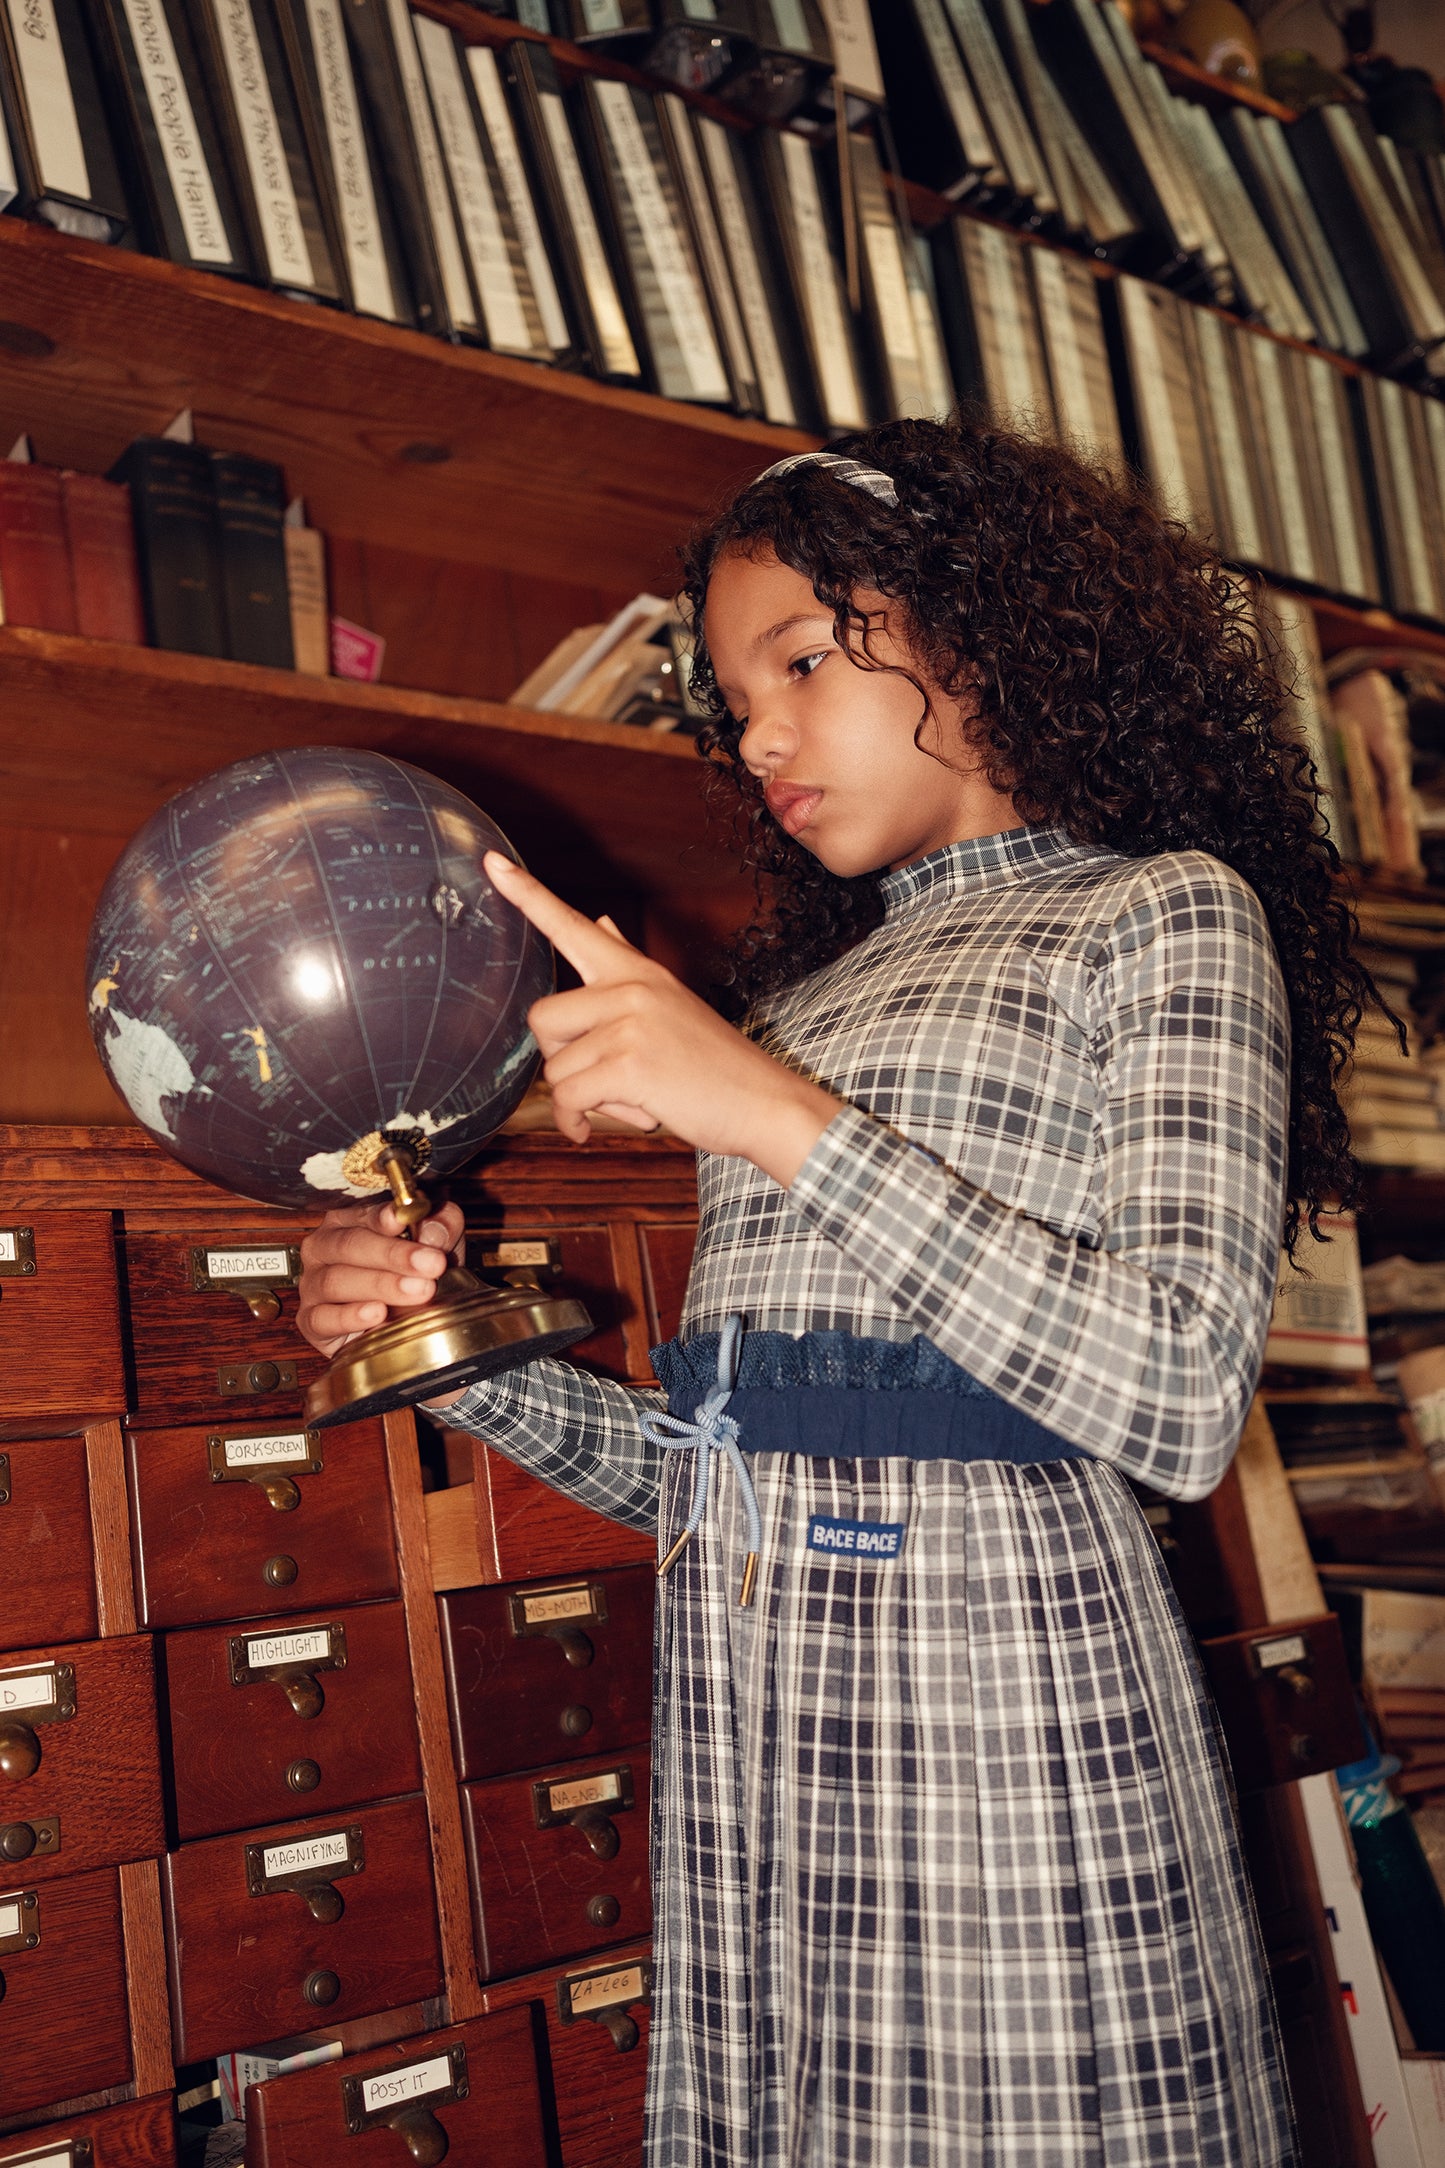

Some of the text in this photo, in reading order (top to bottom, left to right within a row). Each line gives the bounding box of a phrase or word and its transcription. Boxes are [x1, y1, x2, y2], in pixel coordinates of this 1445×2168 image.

[250, 103, 283, 191] Photos
[153, 74, 193, 161] People
[180, 167, 220, 249] Hamid
[350, 843, 420, 856] SOUTH
[348, 895, 440, 913] PACIFI
[362, 953, 437, 970] OCEAN
[210, 1256, 281, 1275] BANDAGES
[225, 1440, 304, 1461] CORKSCREW
[812, 1524, 898, 1553] BACE BACE
[251, 1635, 321, 1661] HIGHLIGHT
[266, 1841, 345, 1870] MAGNIFYING
[370, 2071, 428, 2102] POST IT
